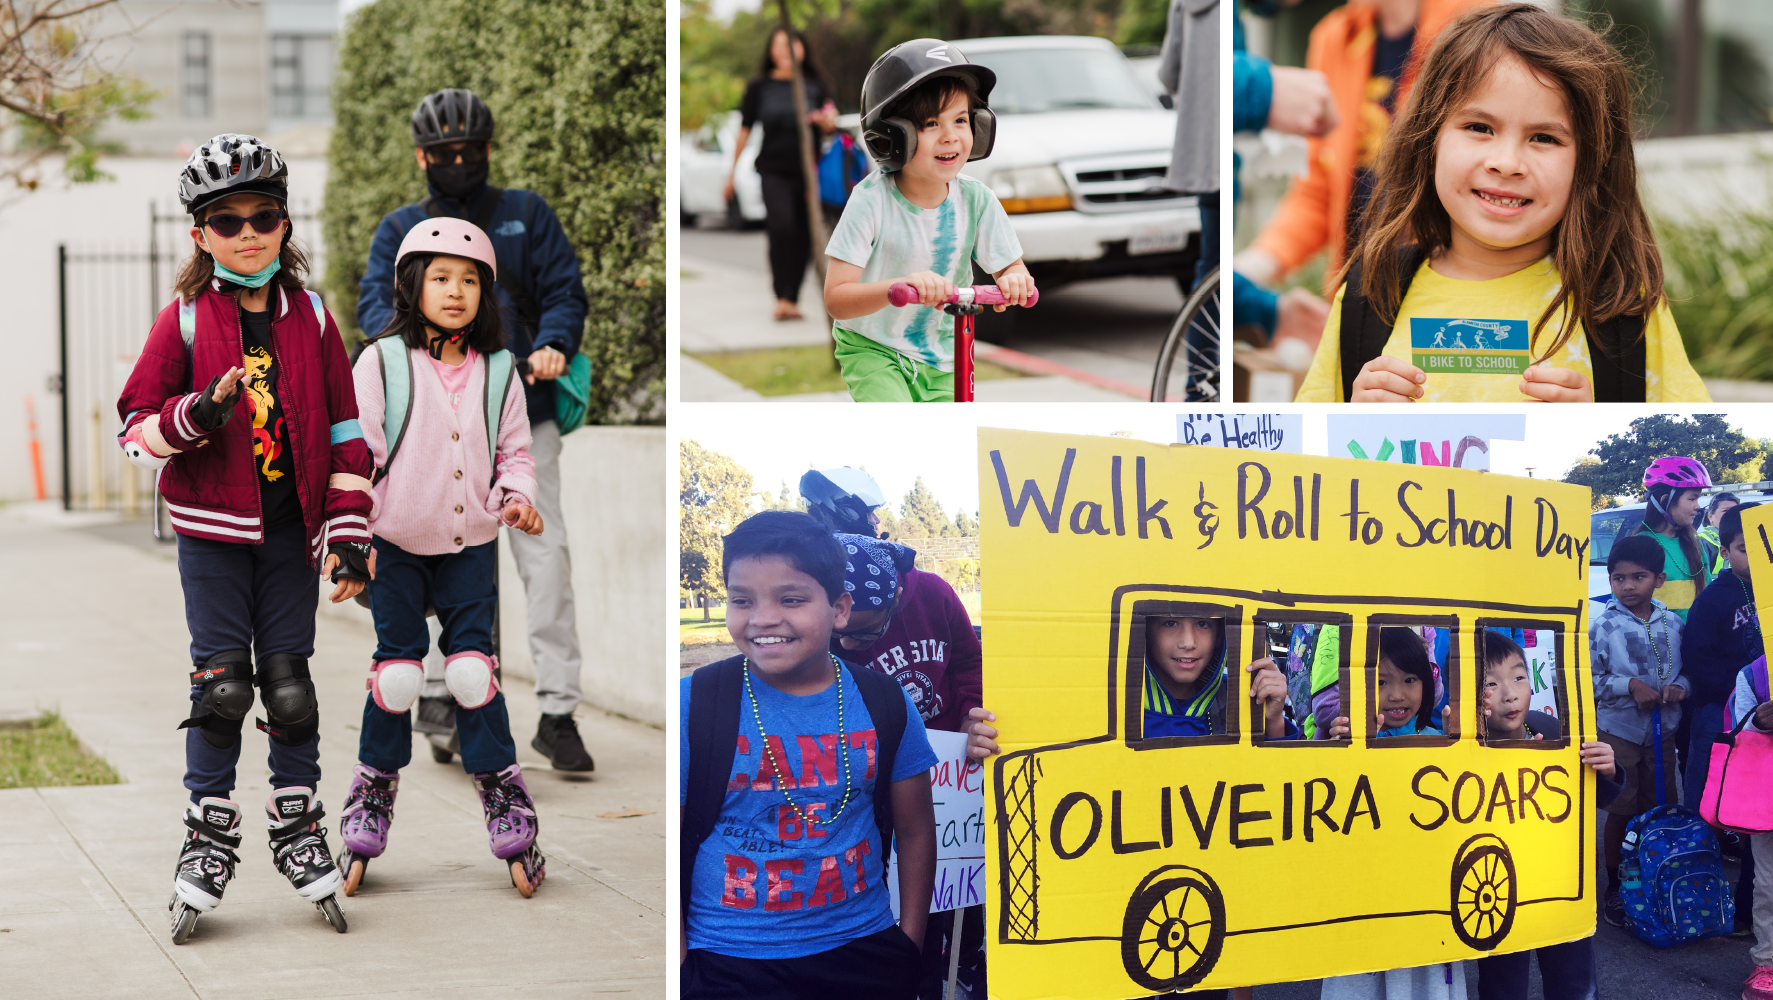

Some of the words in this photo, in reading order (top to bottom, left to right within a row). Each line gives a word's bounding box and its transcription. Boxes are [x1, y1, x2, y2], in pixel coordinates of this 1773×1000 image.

[1422, 356, 1426, 368] I
[1429, 356, 1455, 368] BIKE
[1458, 356, 1473, 368] TO
[1475, 357, 1519, 369] SCHOOL
[1220, 414, 1284, 451] Healthy
[990, 447, 1173, 539] Walk
[1193, 481, 1221, 550] &
[1237, 462, 1321, 541] Roll
[1340, 479, 1383, 545] to
[1396, 480, 1513, 550] School
[1534, 496, 1590, 581] Day
[777, 802, 828, 841] BE
[1049, 774, 1382, 861] OLIVEIRA
[1409, 765, 1573, 832] SOARS
[720, 839, 871, 912] BEAT
